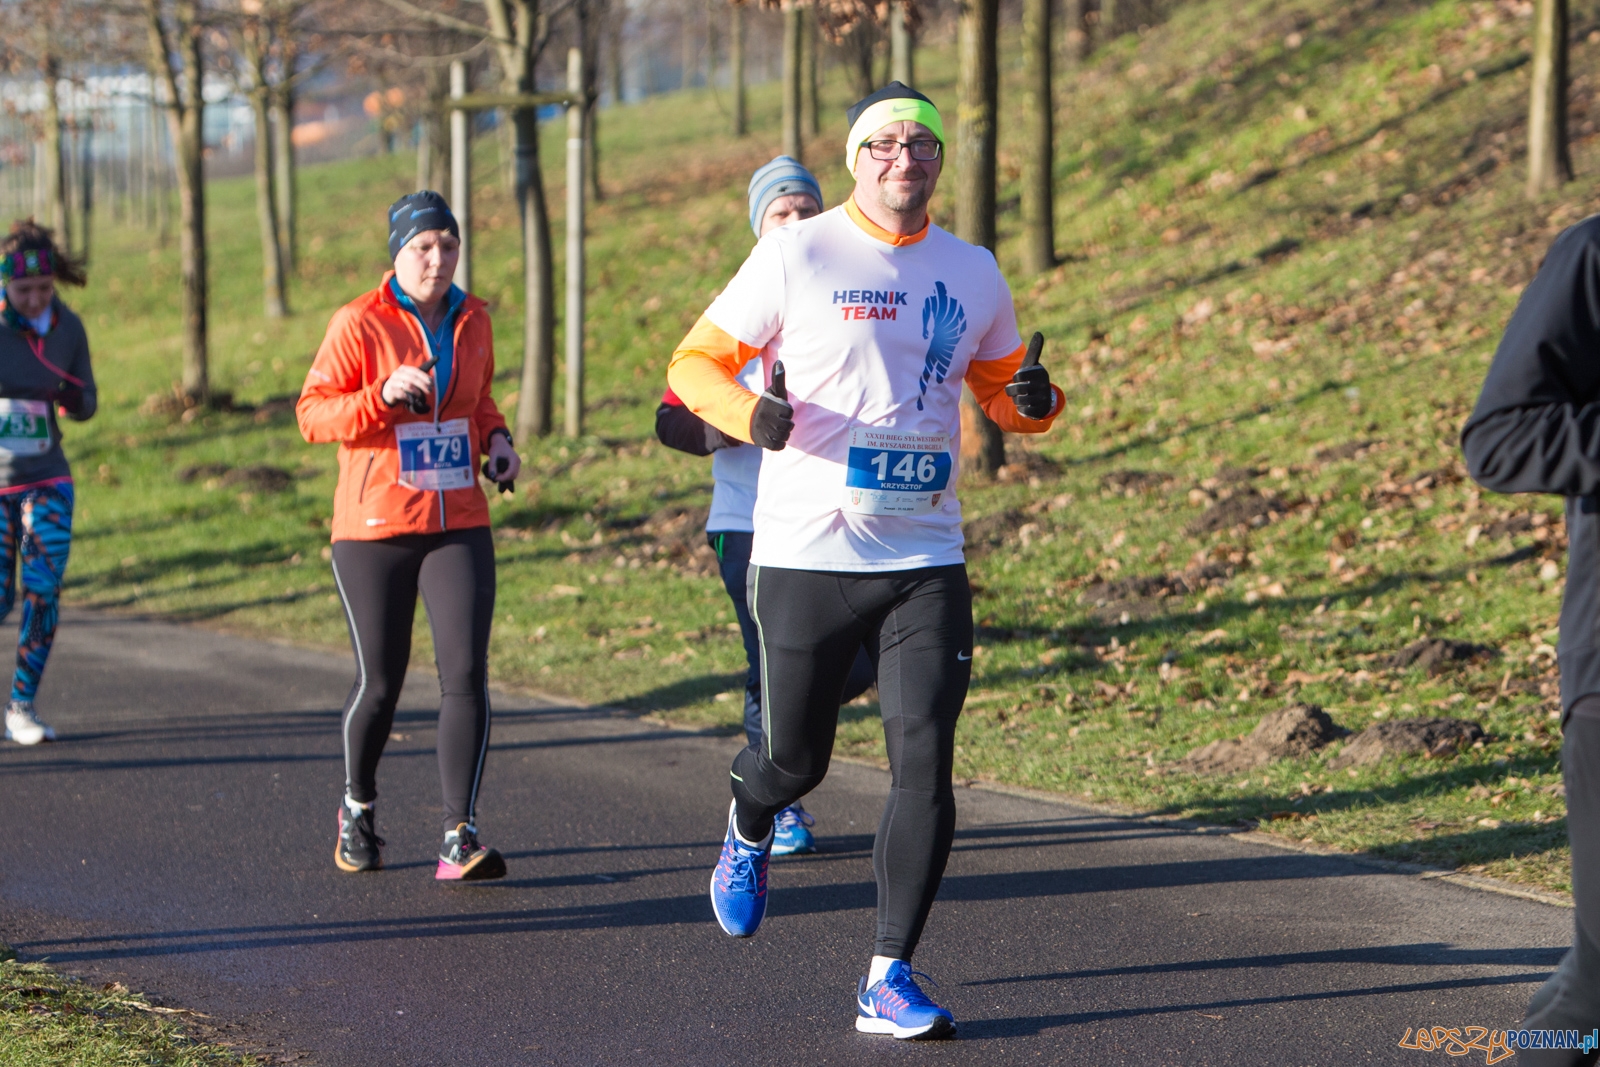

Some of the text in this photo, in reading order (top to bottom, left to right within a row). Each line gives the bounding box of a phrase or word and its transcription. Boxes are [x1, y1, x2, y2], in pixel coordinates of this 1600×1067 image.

[832, 290, 908, 306] HERNIK
[841, 306, 897, 321] TEAM
[416, 437, 462, 464] 179
[879, 441, 916, 450] RYSZARDA
[870, 451, 936, 483] 146
